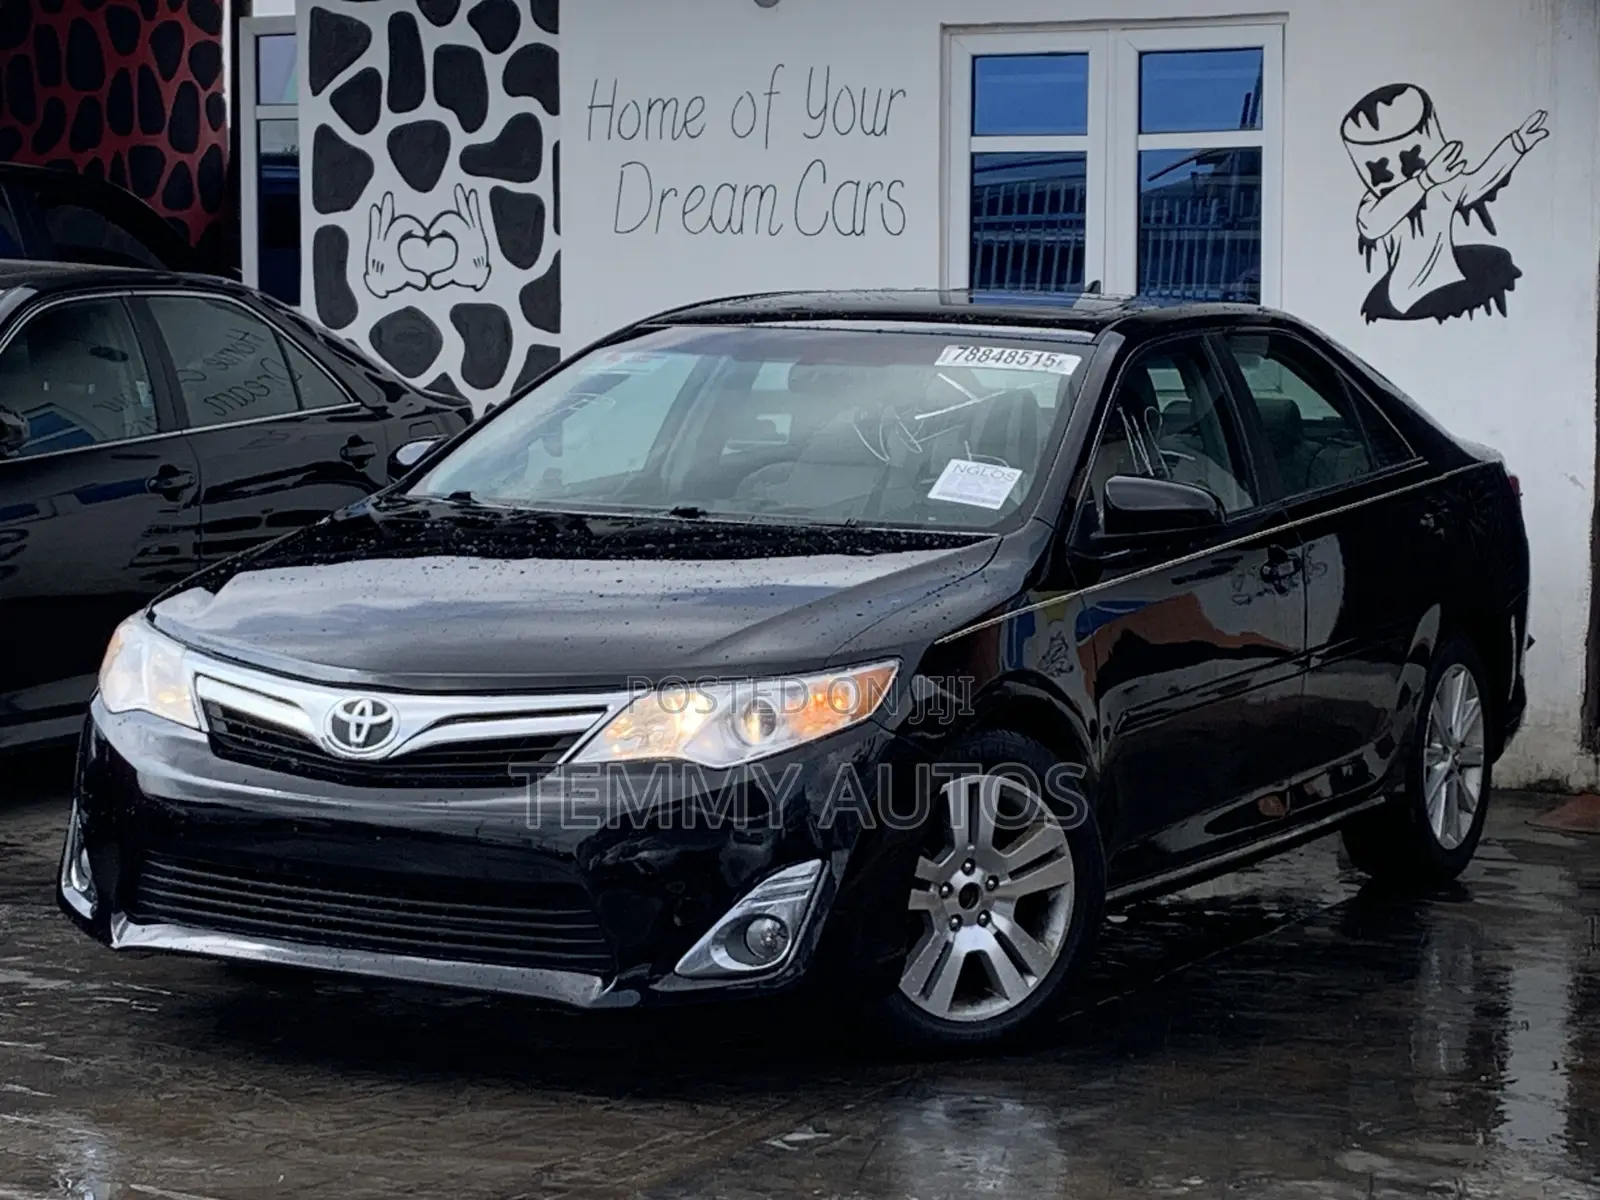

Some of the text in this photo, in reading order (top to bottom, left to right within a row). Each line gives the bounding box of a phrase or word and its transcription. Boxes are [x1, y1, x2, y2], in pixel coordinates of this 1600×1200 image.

[587, 63, 907, 150] Home of Your
[614, 158, 907, 237] Dream Cars
